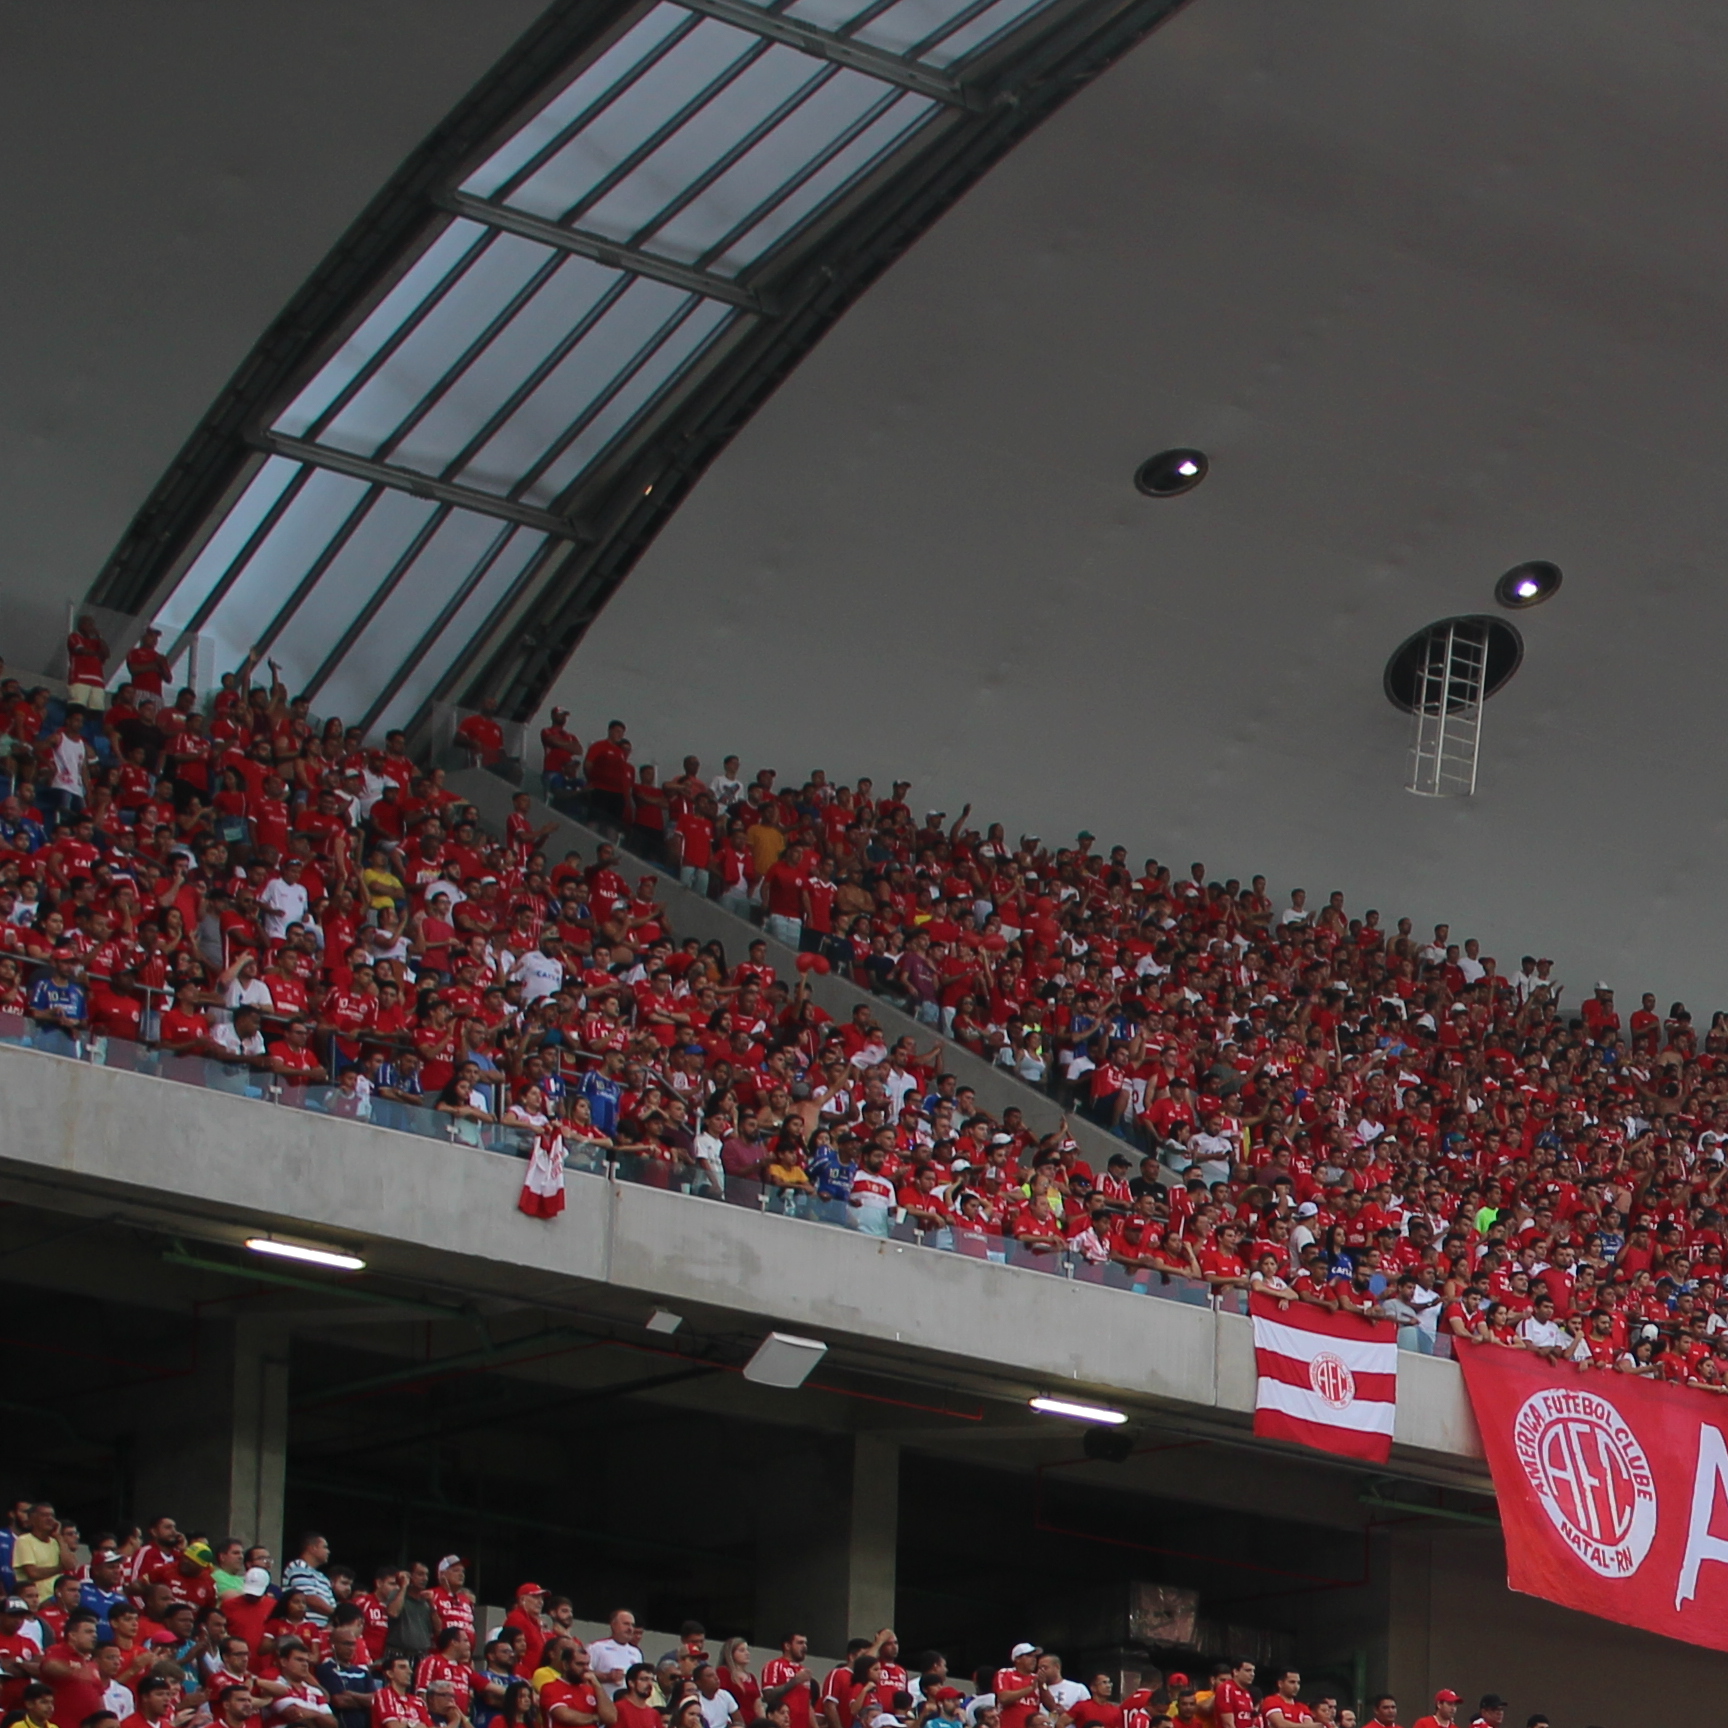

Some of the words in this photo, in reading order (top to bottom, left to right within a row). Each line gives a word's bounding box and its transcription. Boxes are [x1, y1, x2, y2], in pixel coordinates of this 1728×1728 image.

[1317, 1361, 1348, 1401] AFC
[1517, 1403, 1549, 1496] AMERICA
[1542, 1394, 1615, 1429] FUTEBOL
[1614, 1427, 1654, 1503] CLUBE
[1541, 1421, 1632, 1540] AFC
[368, 1607, 381, 1621] 10
[783, 1667, 795, 1679] 10
